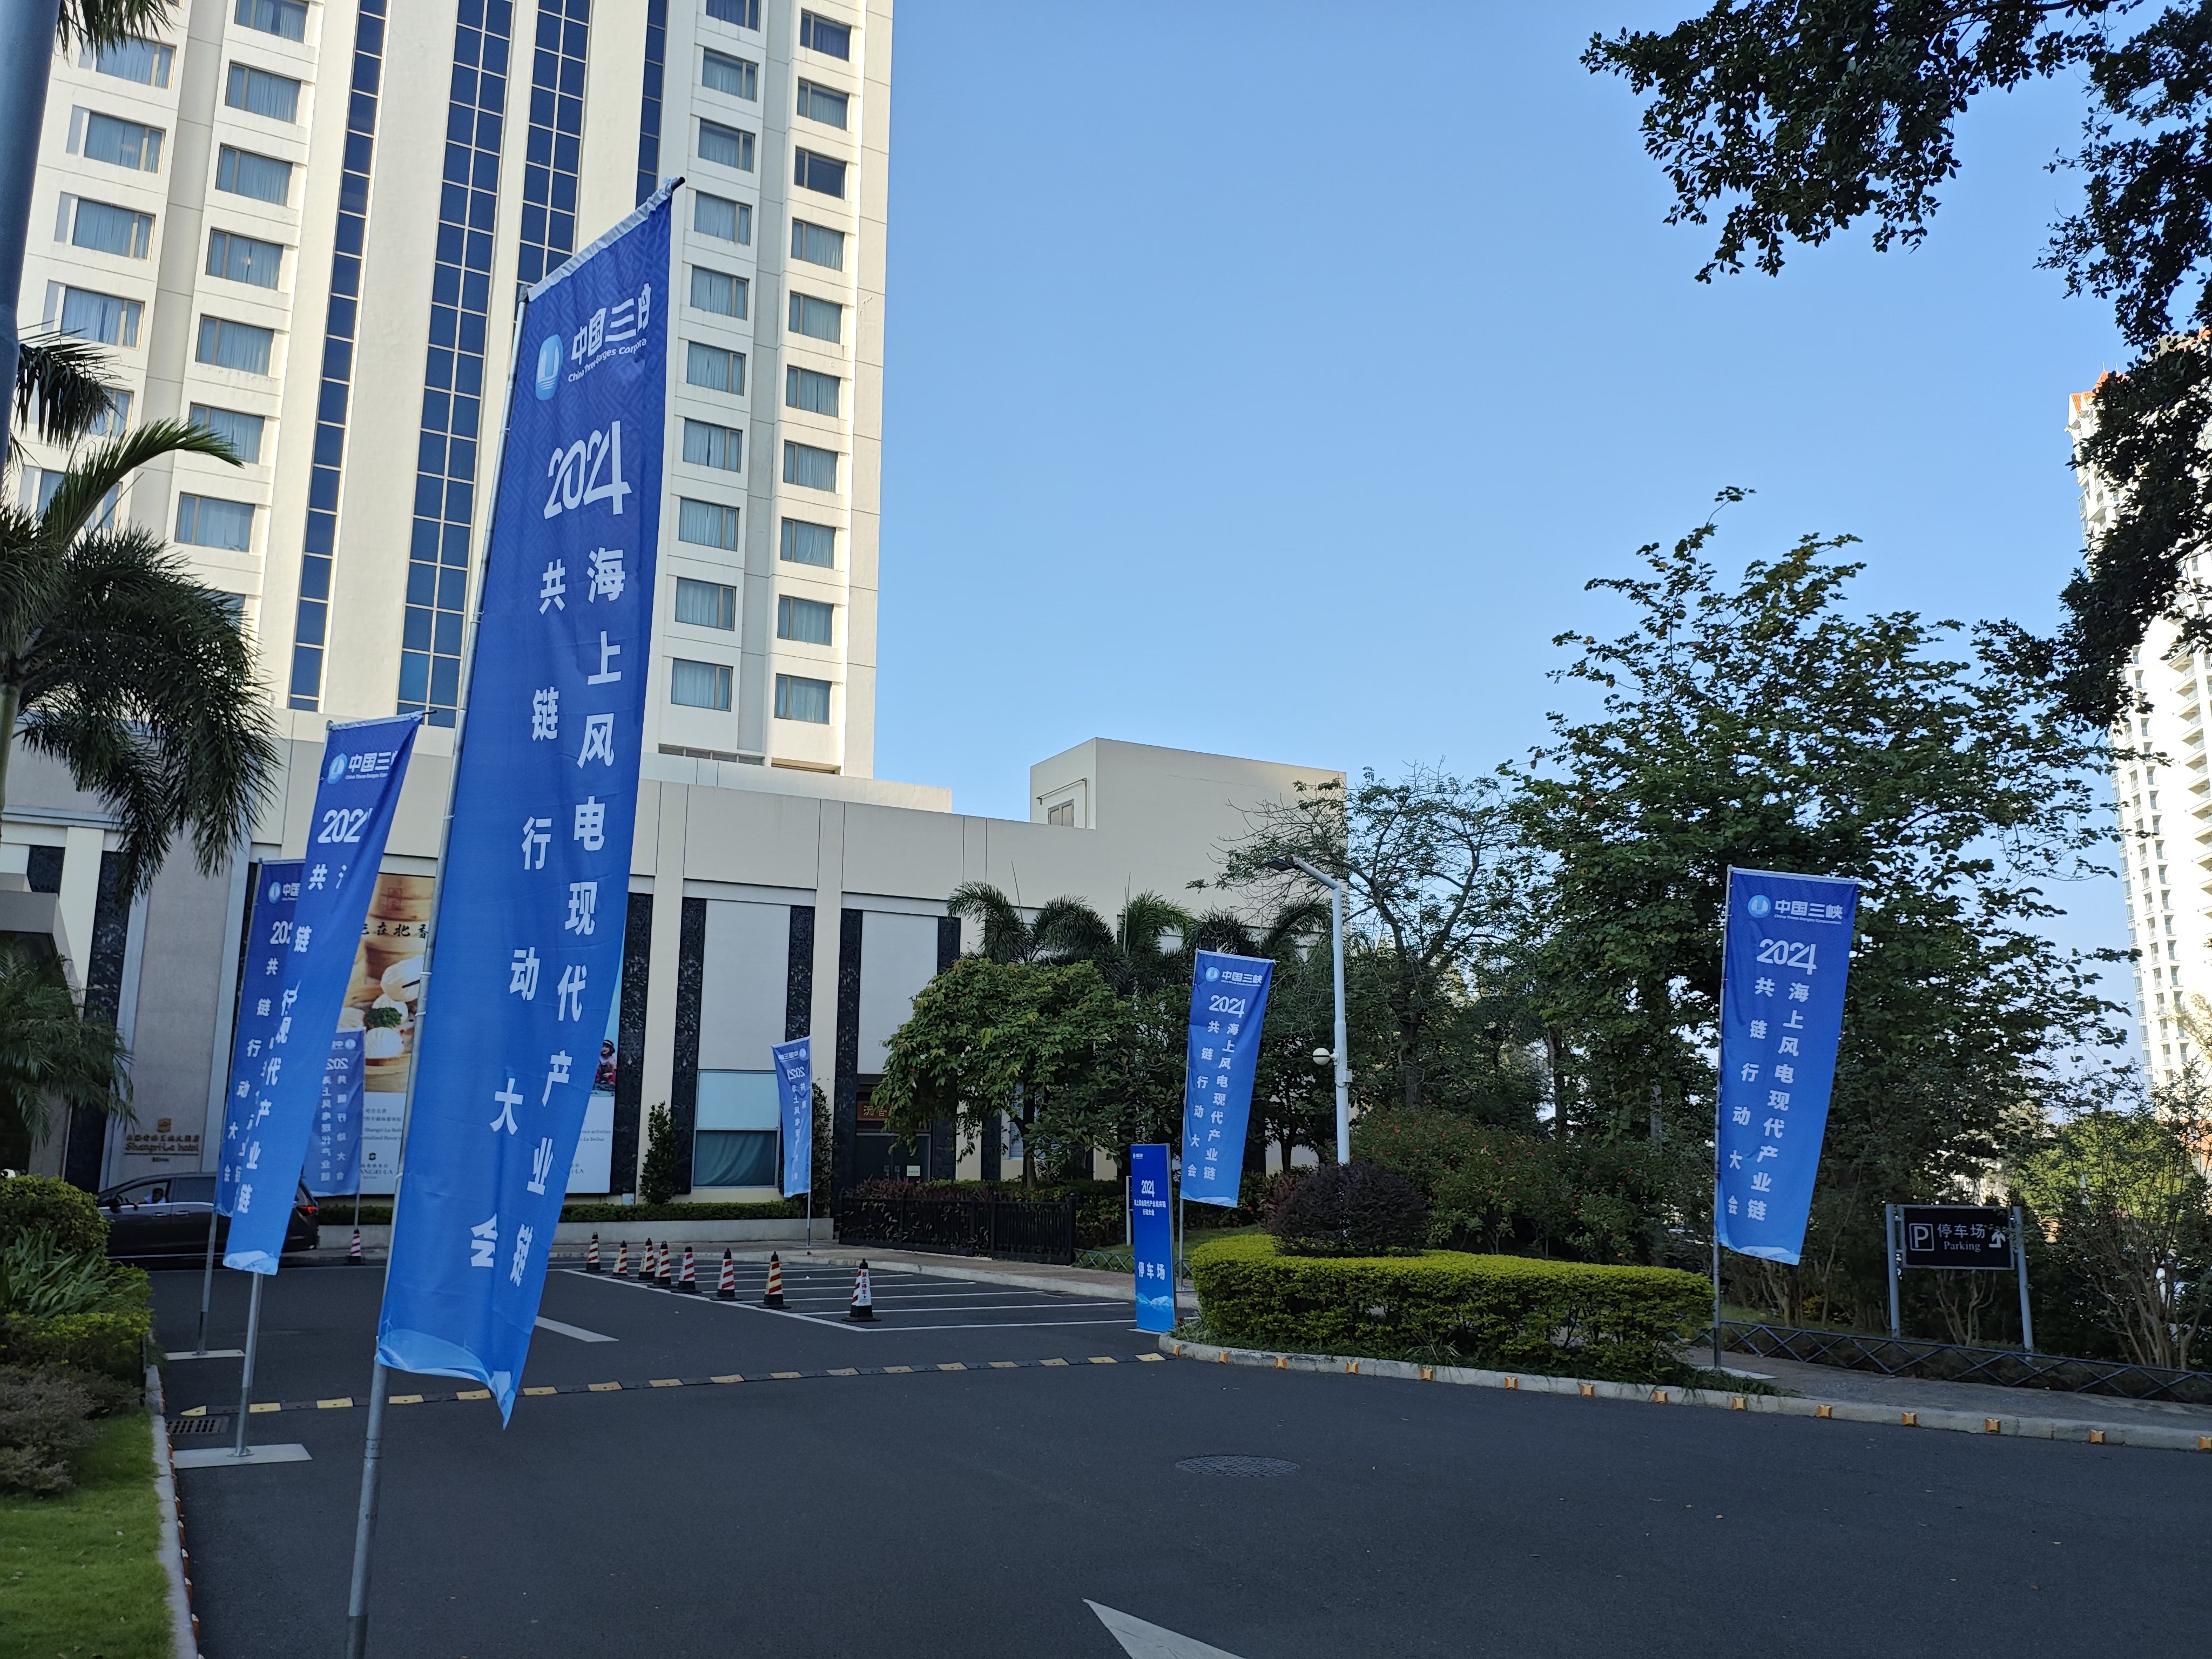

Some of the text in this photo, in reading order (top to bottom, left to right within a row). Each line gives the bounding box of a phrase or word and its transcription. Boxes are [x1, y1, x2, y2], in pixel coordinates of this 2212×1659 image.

[568, 369, 584, 382] China
[596, 348, 616, 363] Gorges
[544, 420, 631, 519] 2024
[1775, 900, 1843, 920] 中国三峡
[1756, 939, 1817, 975] 2024
[1222, 971, 1263, 984] 中国三峡
[1209, 995, 1245, 1018] 2024
[1188, 1020, 1220, 1177] 共链行动大会
[1203, 1023, 1239, 1181] 海上风电现代产业链
[1728, 977, 1775, 1215] 共链行动大会
[1748, 982, 1809, 1221] 海上风电现代产业链
[1141, 1179, 1155, 1198] 2024
[1937, 1223, 1985, 1238] 停车场
[1944, 1241, 1981, 1252] Parking
[1138, 1262, 1165, 1280] 停车场
